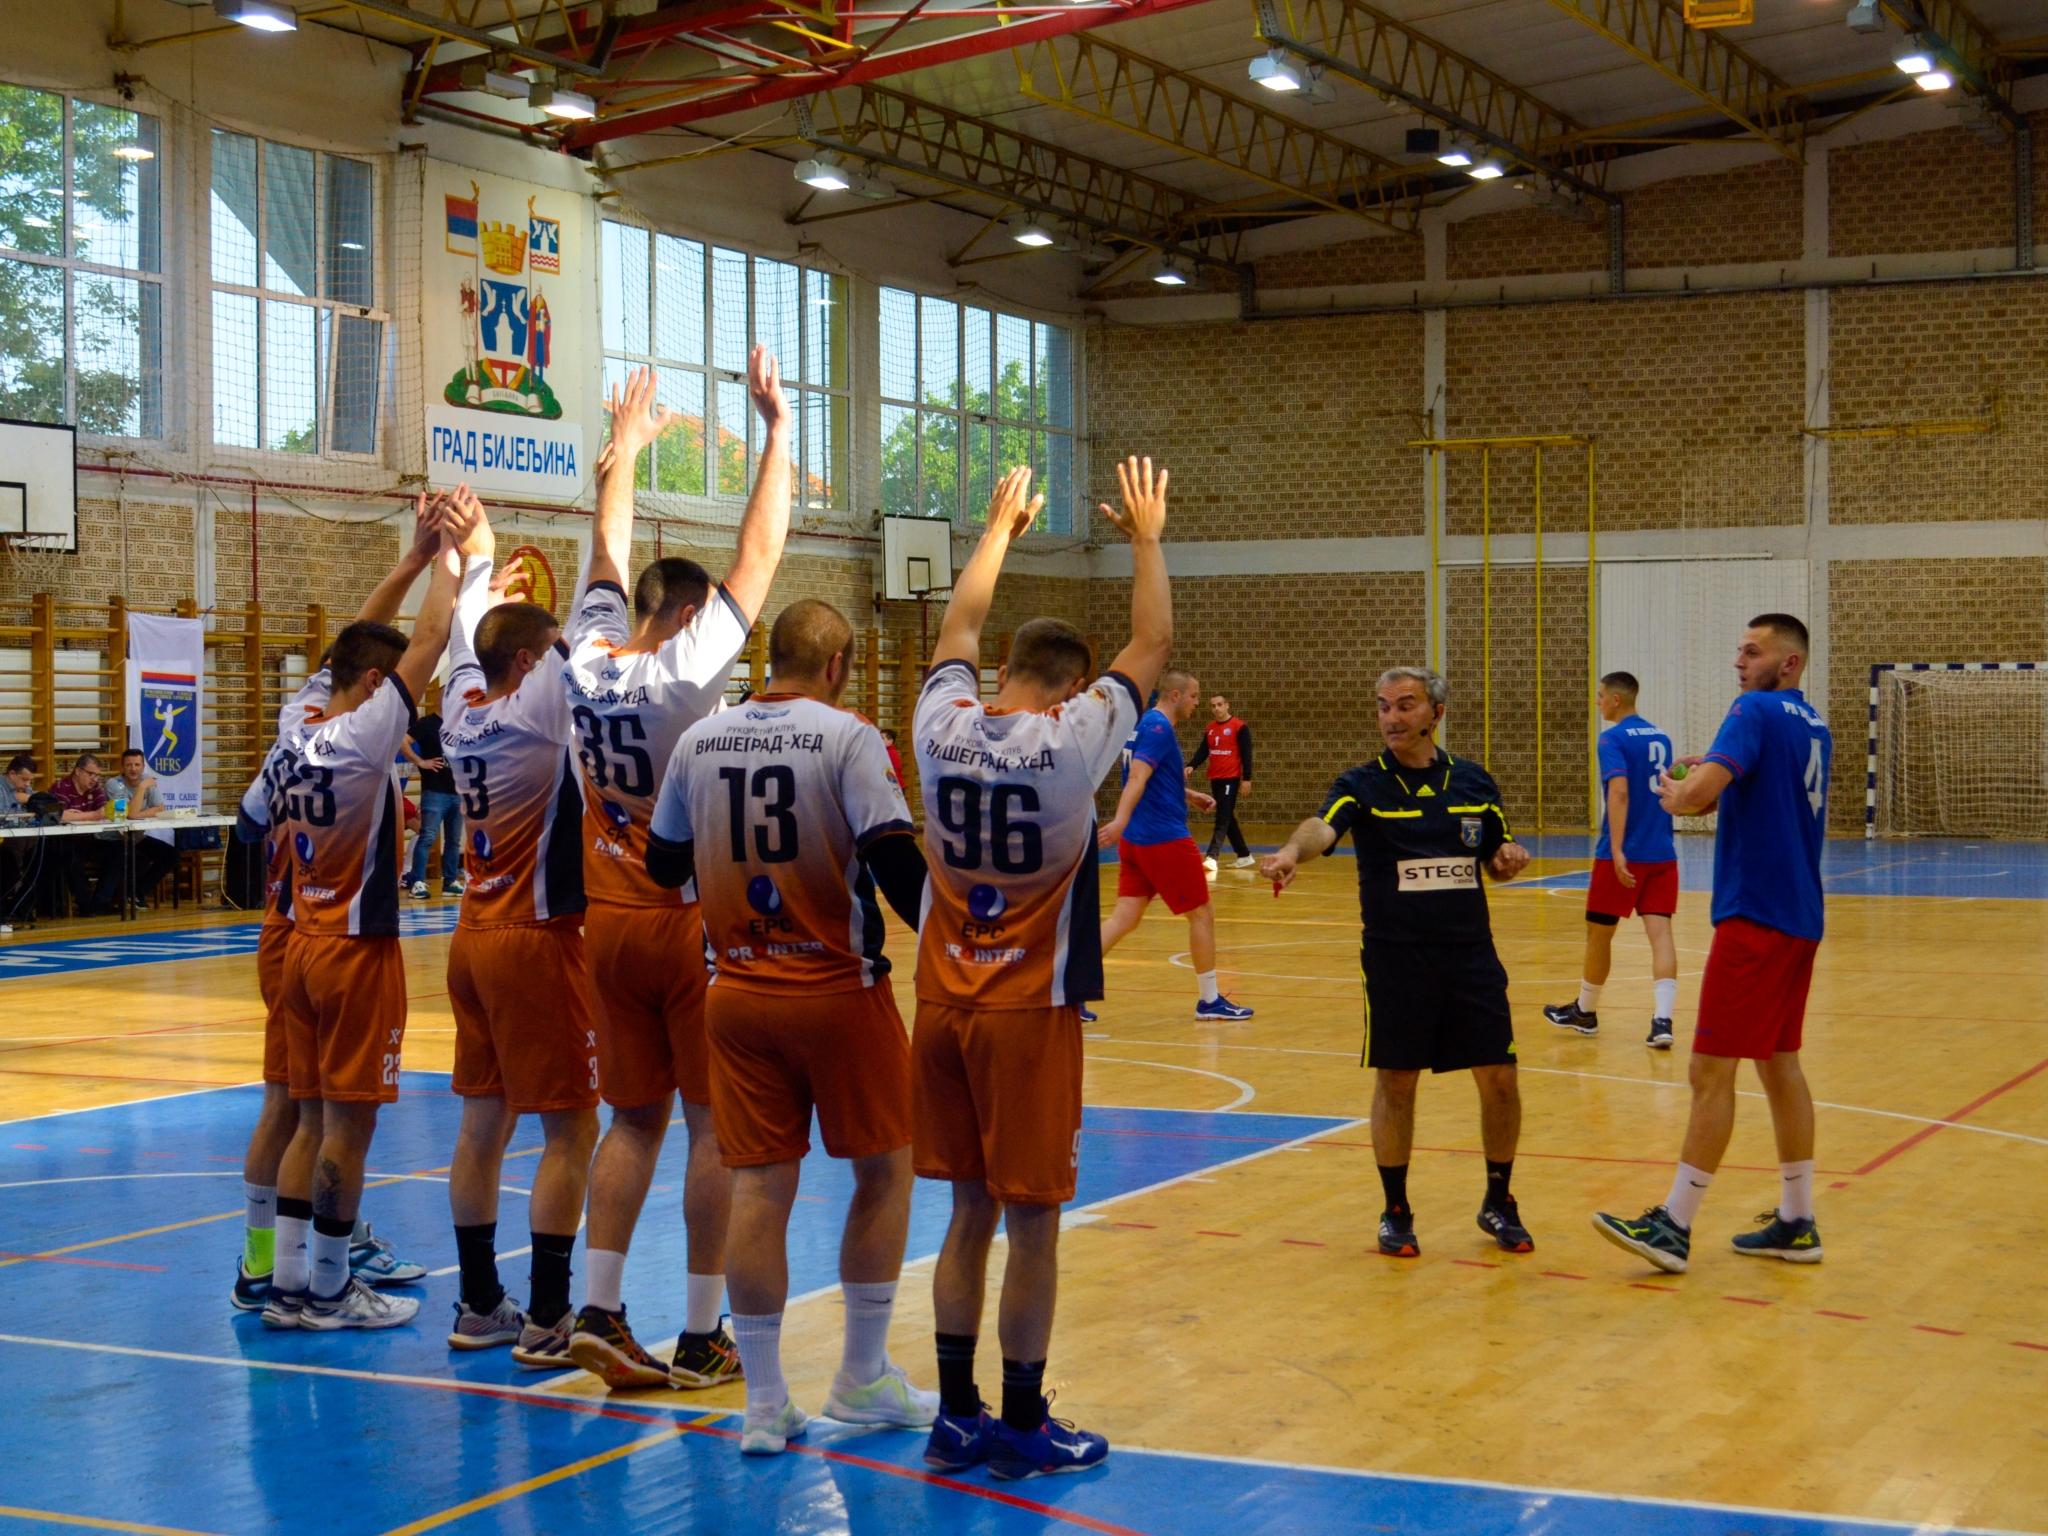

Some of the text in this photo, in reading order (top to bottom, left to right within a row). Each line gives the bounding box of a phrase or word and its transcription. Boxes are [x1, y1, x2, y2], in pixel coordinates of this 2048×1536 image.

[433, 426, 577, 477] ГРАД БИЈЕЉИНА
[571, 704, 655, 798] 35
[695, 733, 824, 755] ВИШЕГРАД-ХЕД
[1648, 740, 1668, 794] 3
[1803, 737, 1823, 820] 4
[719, 764, 799, 864] 13
[936, 776, 1043, 875] 96
[1404, 864, 1474, 880] STECO
[749, 917, 795, 936] EPC
[962, 921, 1005, 940] EPC
